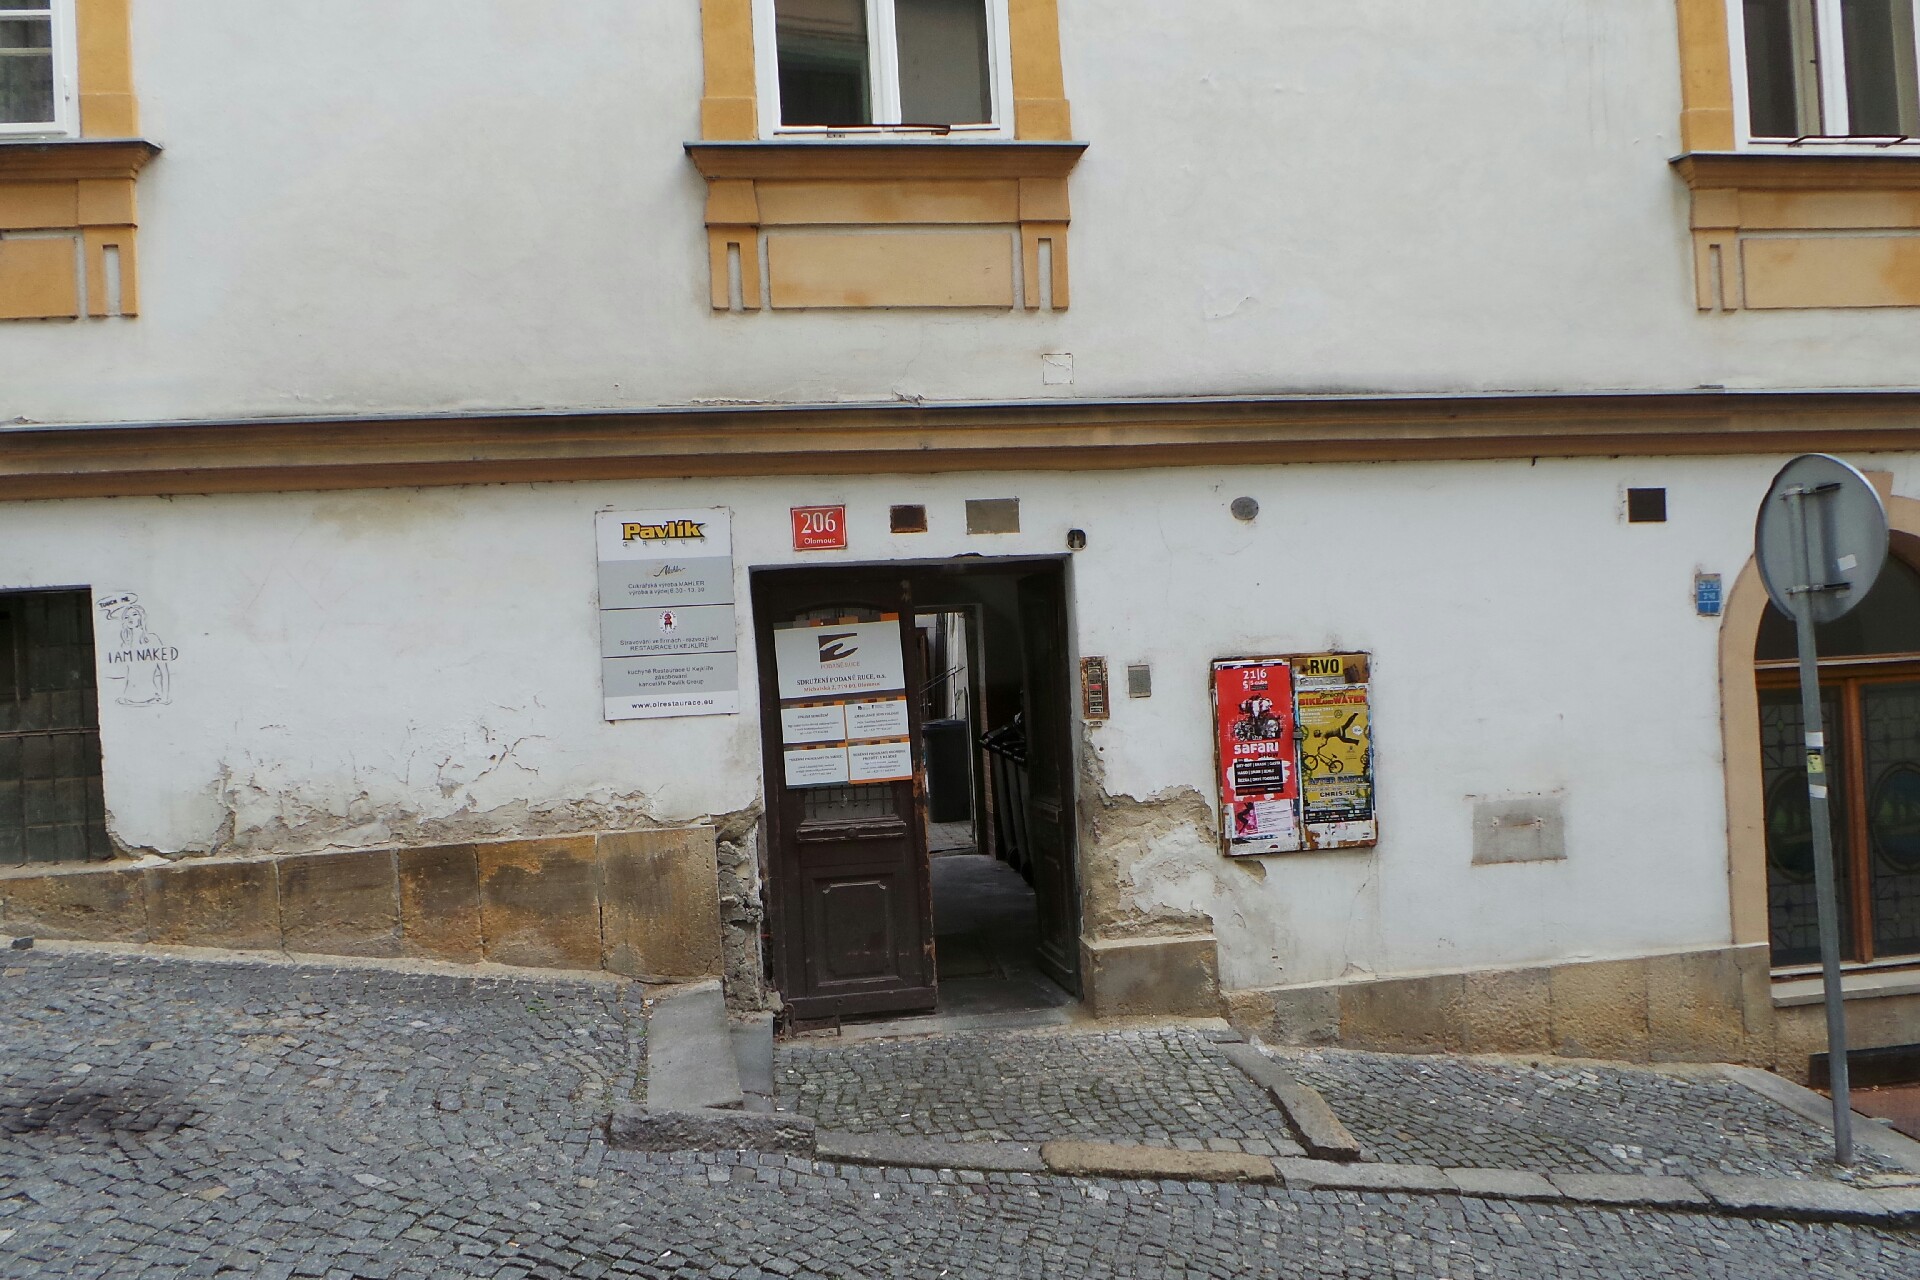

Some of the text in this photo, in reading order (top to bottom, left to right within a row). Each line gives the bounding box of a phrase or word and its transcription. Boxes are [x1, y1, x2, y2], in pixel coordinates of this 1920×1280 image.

[801, 511, 836, 534] 206
[621, 520, 706, 541] Pavlík
[804, 537, 836, 545] Olomouc
[627, 580, 705, 590] Cukrářská výroba MAHLER
[628, 588, 649, 596] výroba
[108, 646, 179, 664] I AM NAKED
[1310, 658, 1340, 674] RVO
[796, 676, 829, 686] SDRUŽENÍ
[829, 673, 856, 683] PODANÉ
[1319, 790, 1343, 798] CHRIS
